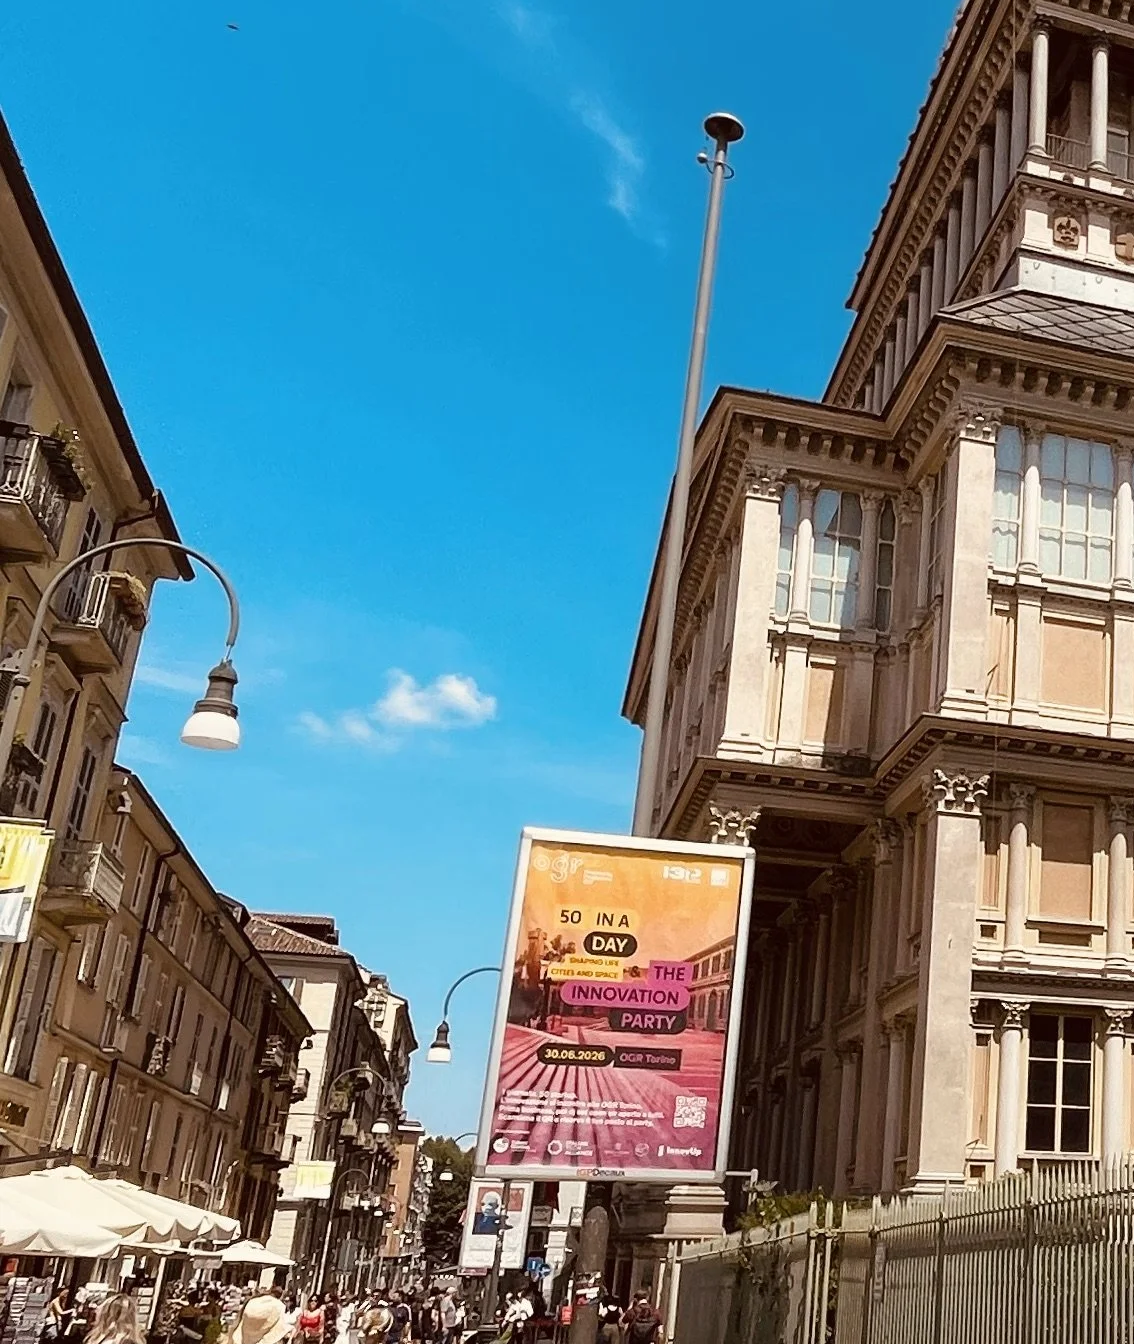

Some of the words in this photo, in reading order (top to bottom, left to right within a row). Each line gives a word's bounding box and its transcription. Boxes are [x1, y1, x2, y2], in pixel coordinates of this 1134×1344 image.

[560, 910, 581, 924] 50
[597, 912, 614, 927] IN
[618, 915, 629, 928] A
[592, 936, 628, 953] DAY
[551, 968, 575, 976] CITIES
[595, 971, 619, 979] SPACE
[654, 966, 686, 981] THE
[572, 985, 680, 1005] INNOVATION
[621, 1013, 676, 1030] PARTY
[620, 1053, 644, 1062] OGR
[646, 1054, 676, 1064] Torino
